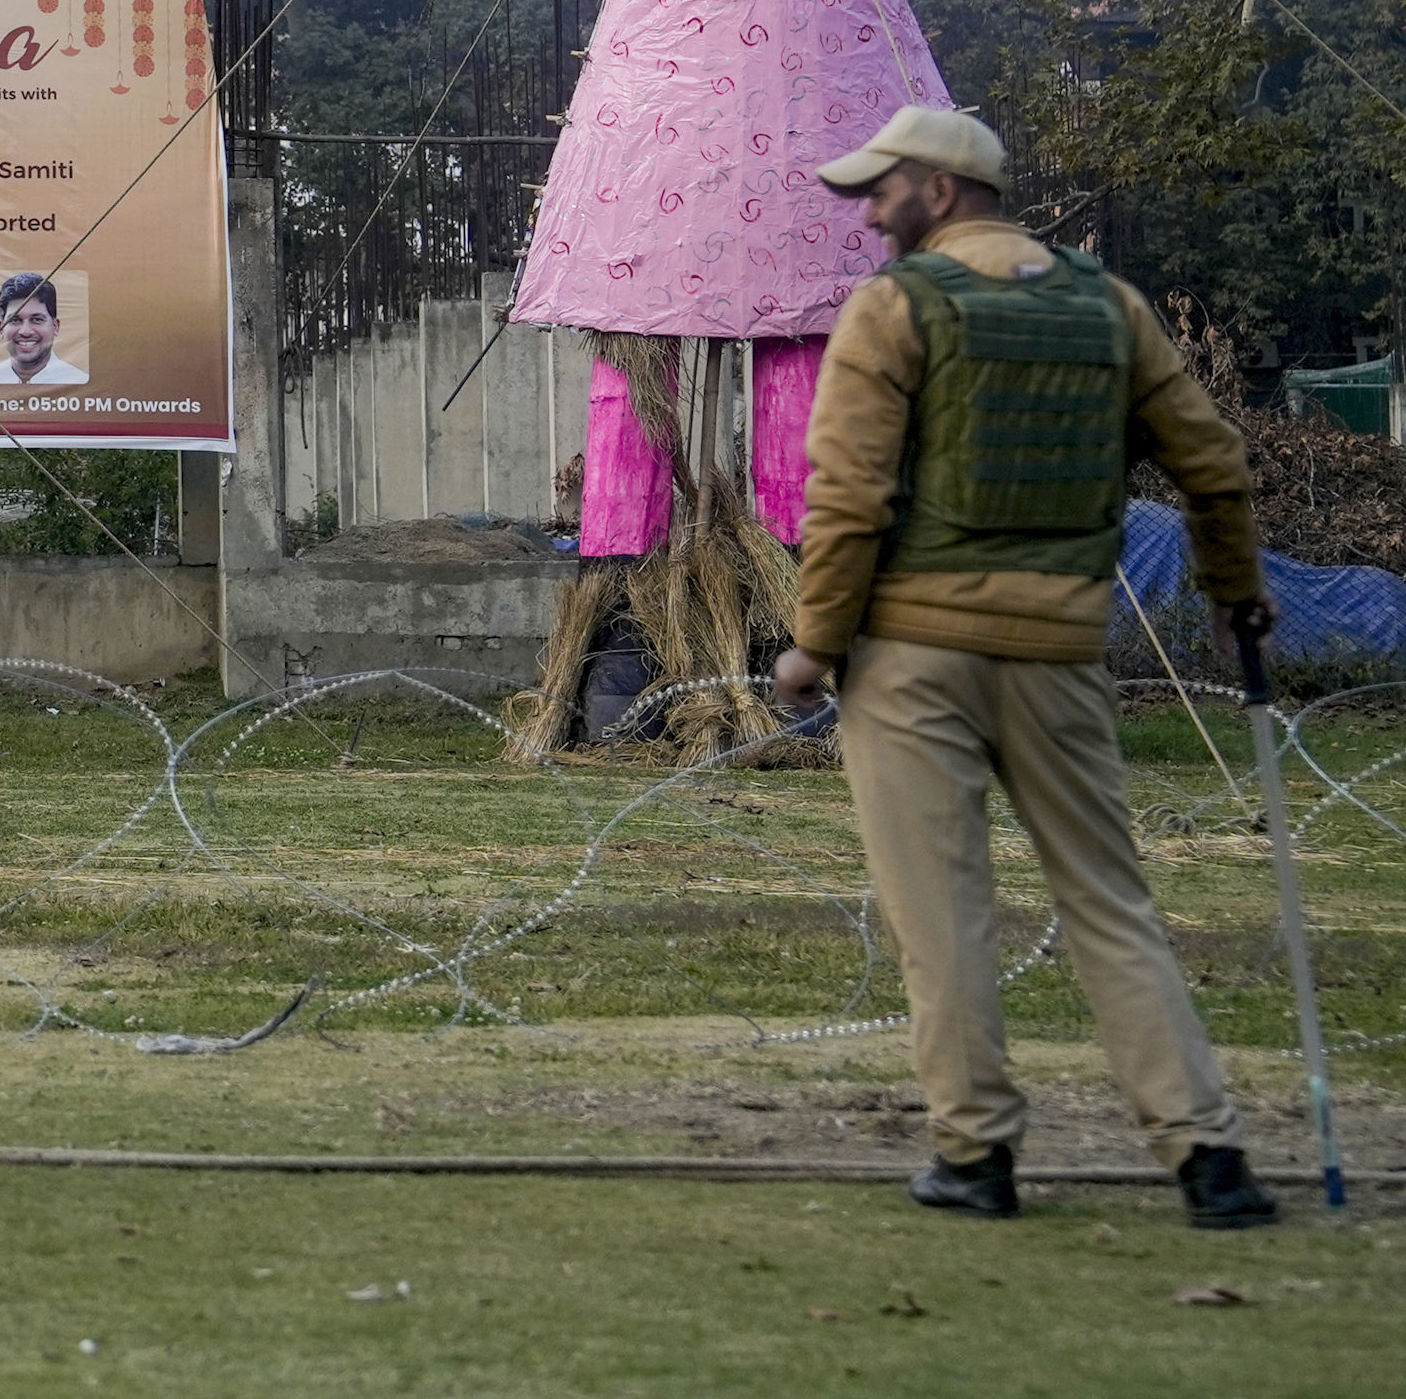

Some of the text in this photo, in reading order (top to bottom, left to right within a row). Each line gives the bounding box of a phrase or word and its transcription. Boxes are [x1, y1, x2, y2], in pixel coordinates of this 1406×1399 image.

[21, 87, 57, 100] with
[28, 397, 80, 412] 05:00
[85, 398, 111, 412] PM
[116, 398, 202, 413] Onwards
